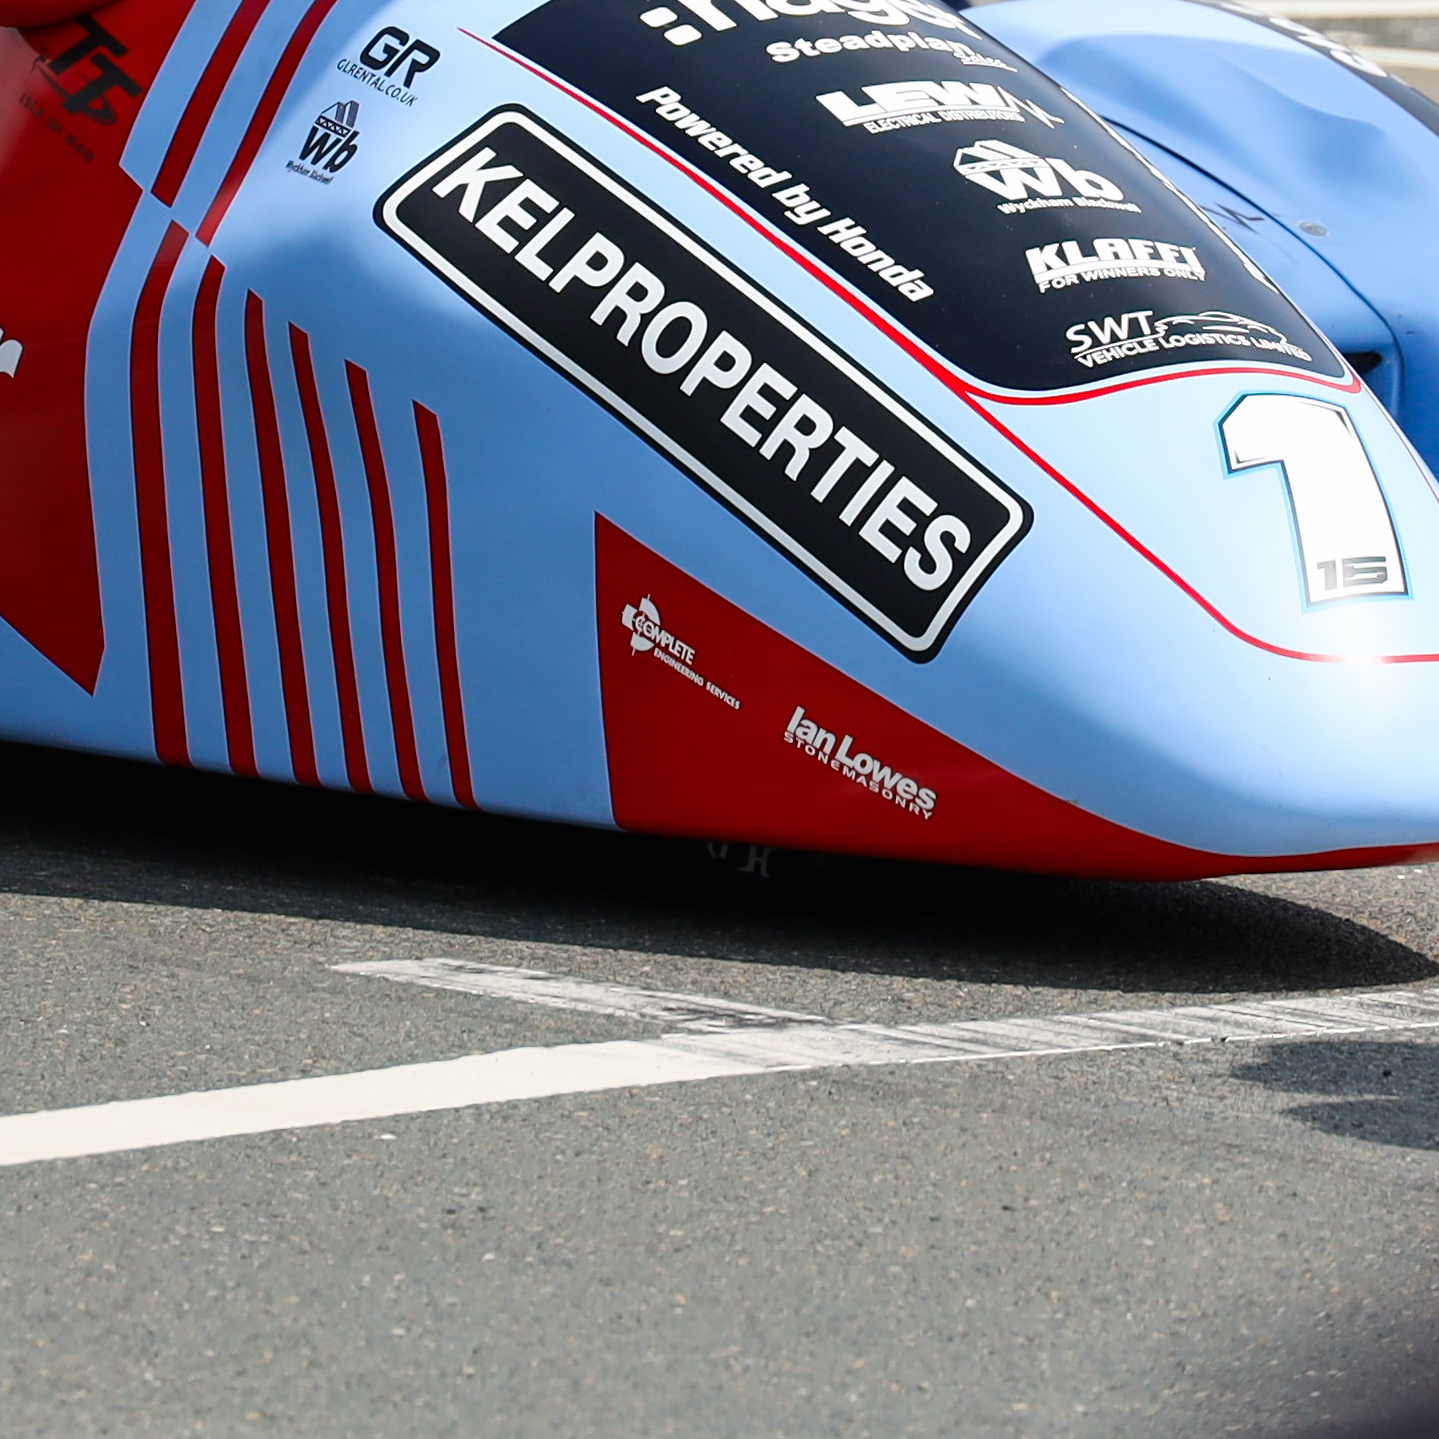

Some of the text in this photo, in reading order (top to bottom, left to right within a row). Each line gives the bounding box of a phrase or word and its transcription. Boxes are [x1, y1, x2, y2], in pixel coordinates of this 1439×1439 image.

[359, 26, 441, 89] GR
[766, 30, 977, 63] Steadplan
[863, 112, 942, 134] ELECTRICAL
[636, 86, 934, 302] Powered by Honda
[997, 196, 1074, 215] Wyckham
[1037, 267, 1208, 294] FOR WINNERS ONLY
[1065, 310, 1158, 354] SWT
[1074, 332, 1313, 369] VEHICLE LOGISTICS LIMITED
[432, 146, 972, 592] KELPROPERTIES
[1219, 391, 1409, 607] 1
[634, 613, 696, 666] COMPLETE
[652, 647, 742, 710] ENGINEERING SERVICES
[783, 729, 934, 821] STONEMASONRY
[785, 705, 938, 812] Ian Lowes
